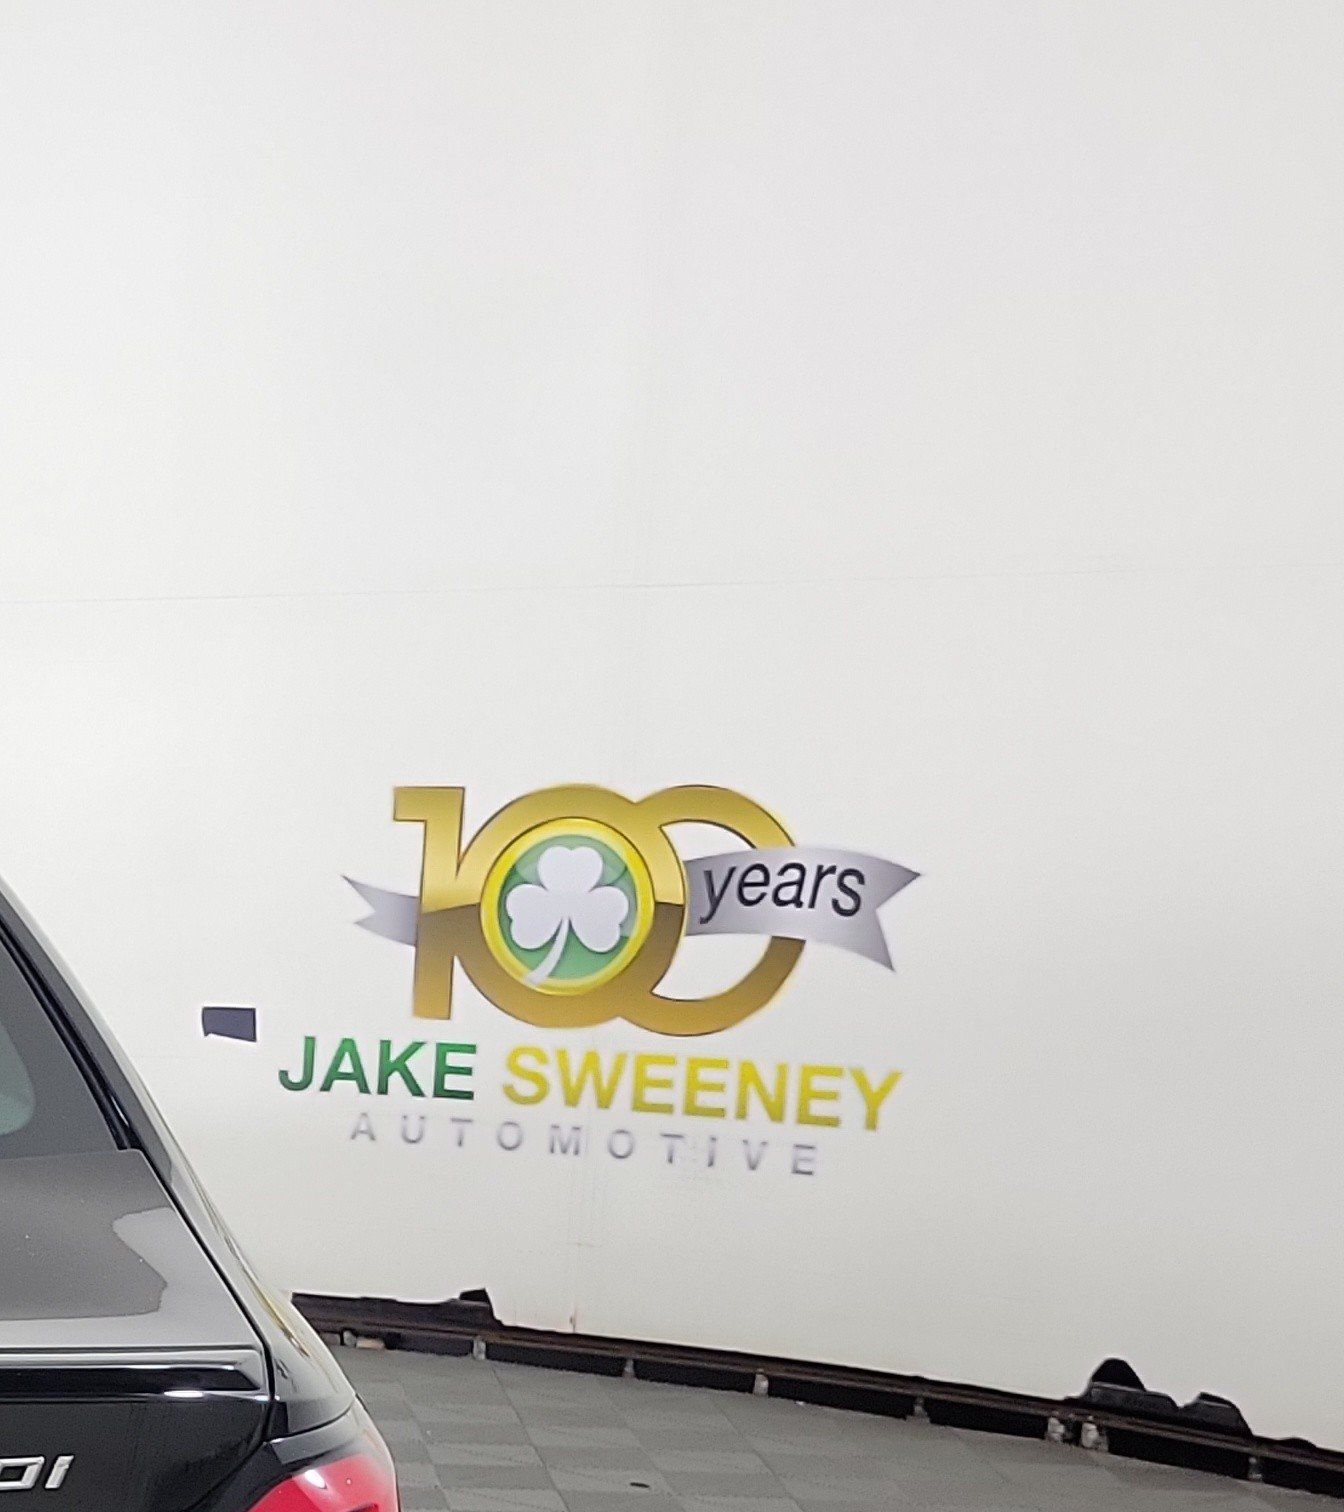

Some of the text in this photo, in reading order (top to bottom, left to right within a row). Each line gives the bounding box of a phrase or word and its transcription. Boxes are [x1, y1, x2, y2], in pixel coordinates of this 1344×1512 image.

[393, 784, 806, 1037] 100
[700, 860, 866, 924] years
[278, 1036, 903, 1131] JAKE SWEENEY
[350, 1112, 816, 1175] AUTOMOTIVE
